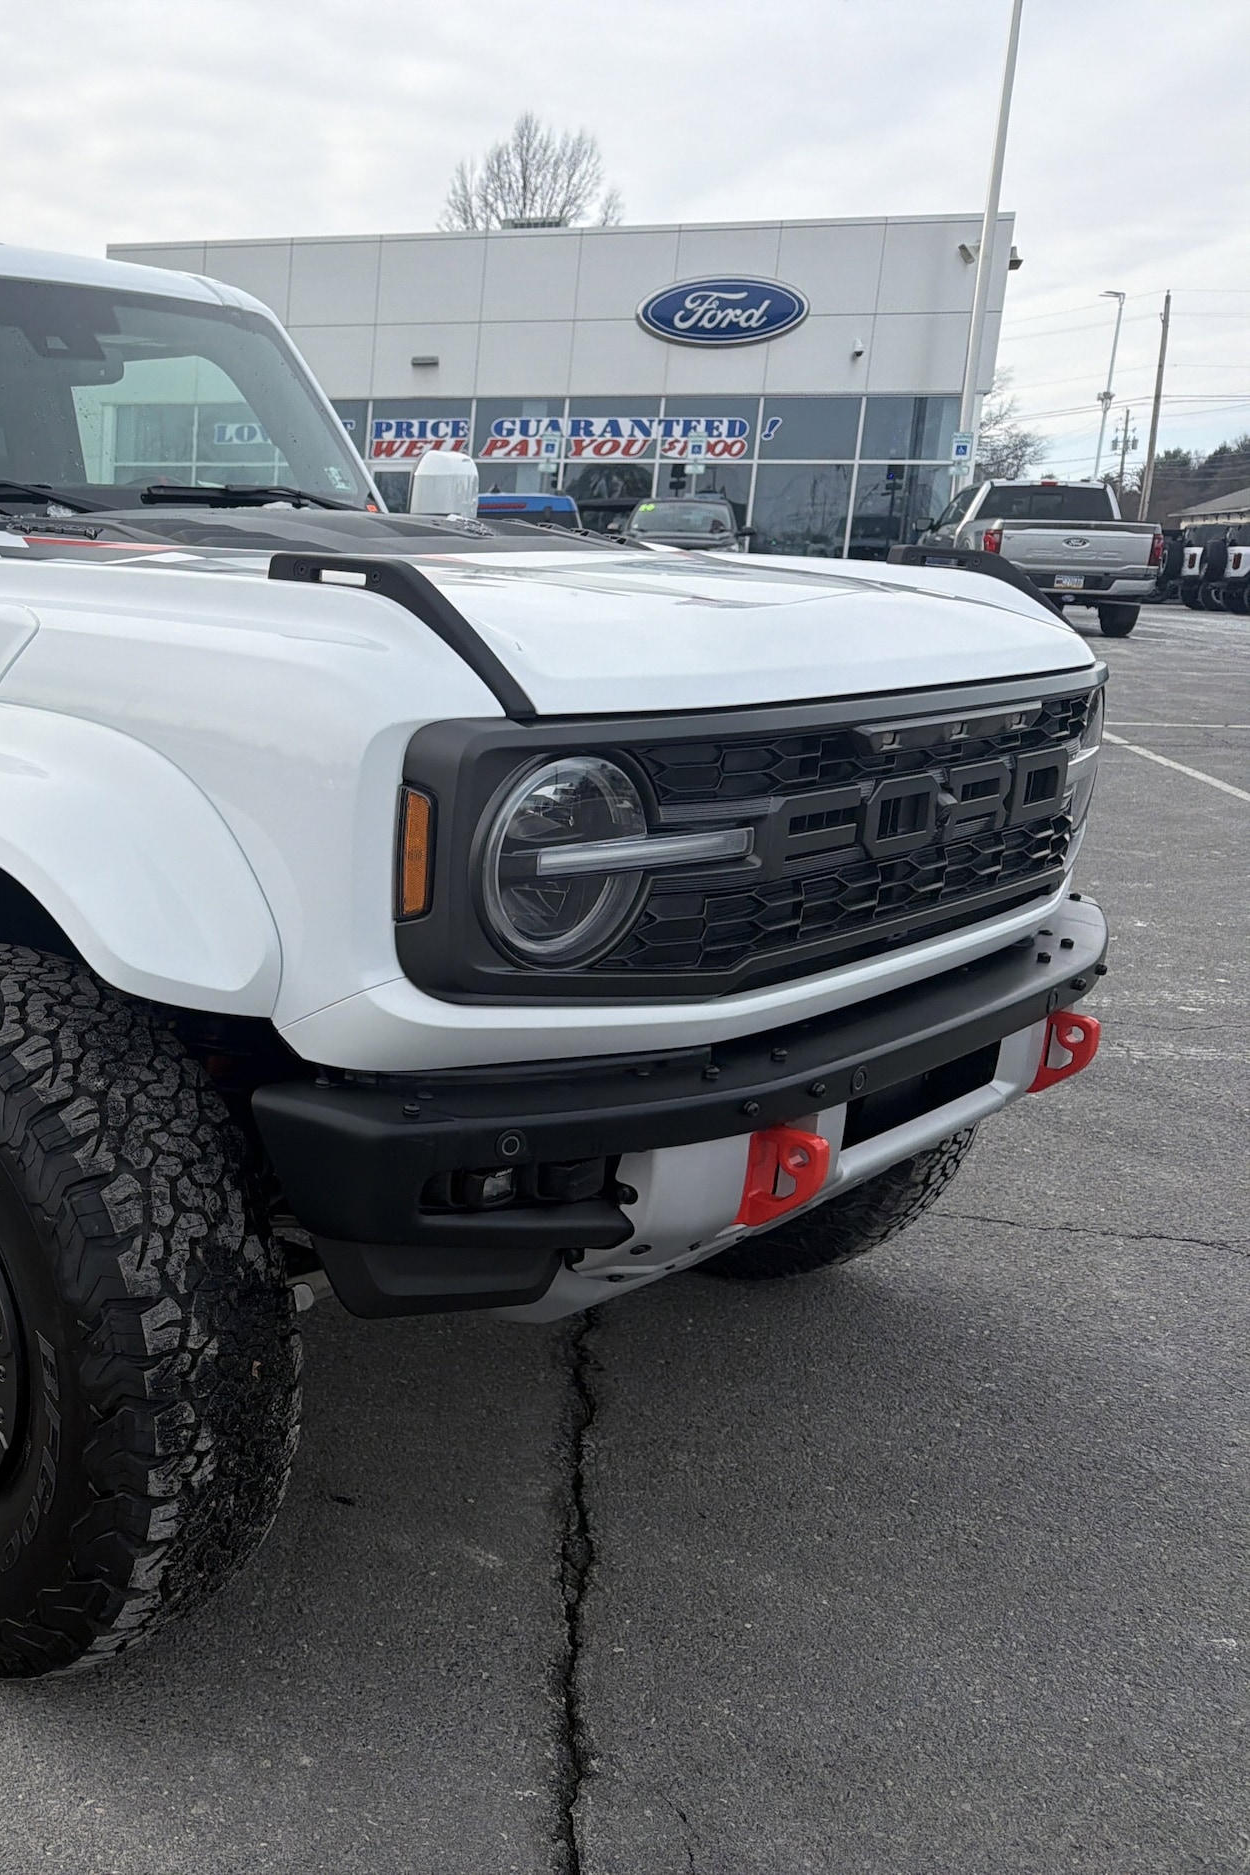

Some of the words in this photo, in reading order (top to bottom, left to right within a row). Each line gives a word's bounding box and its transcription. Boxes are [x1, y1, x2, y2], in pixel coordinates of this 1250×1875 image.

[673, 291, 771, 329] Ford
[372, 420, 469, 439] PRICE
[493, 419, 748, 438] GUARANTEED
[571, 439, 648, 457] YOU
[662, 439, 746, 457] $100
[758, 749, 1069, 882] FORD
